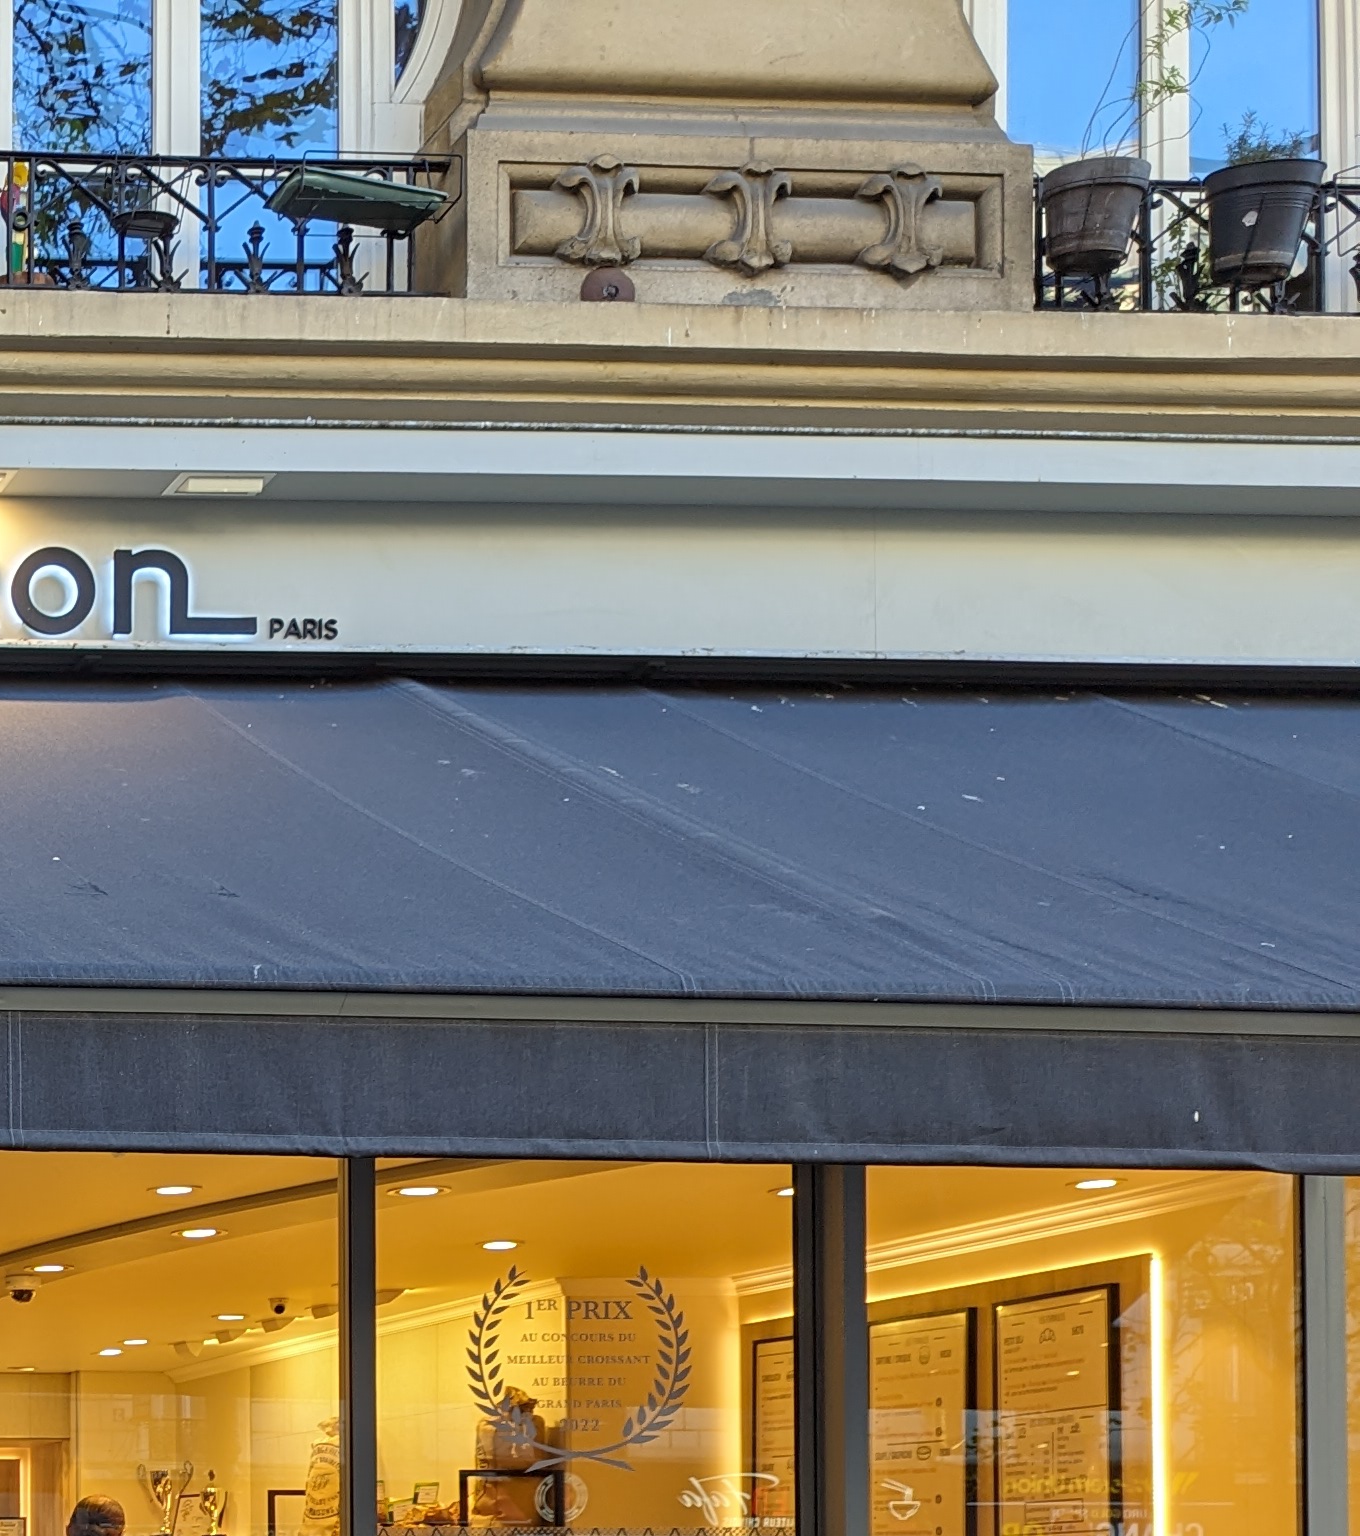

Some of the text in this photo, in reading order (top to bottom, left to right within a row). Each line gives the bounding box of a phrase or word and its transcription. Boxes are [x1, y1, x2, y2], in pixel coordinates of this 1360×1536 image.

[268, 617, 339, 642] PARIS
[524, 1299, 634, 1320] 1ER PRIX
[520, 1333, 637, 1342] AU CONCOURS DU
[577, 1355, 651, 1365] CROISSANT
[532, 1377, 549, 1387] AU
[608, 1377, 627, 1387] DU
[585, 1399, 623, 1409] PARIS
